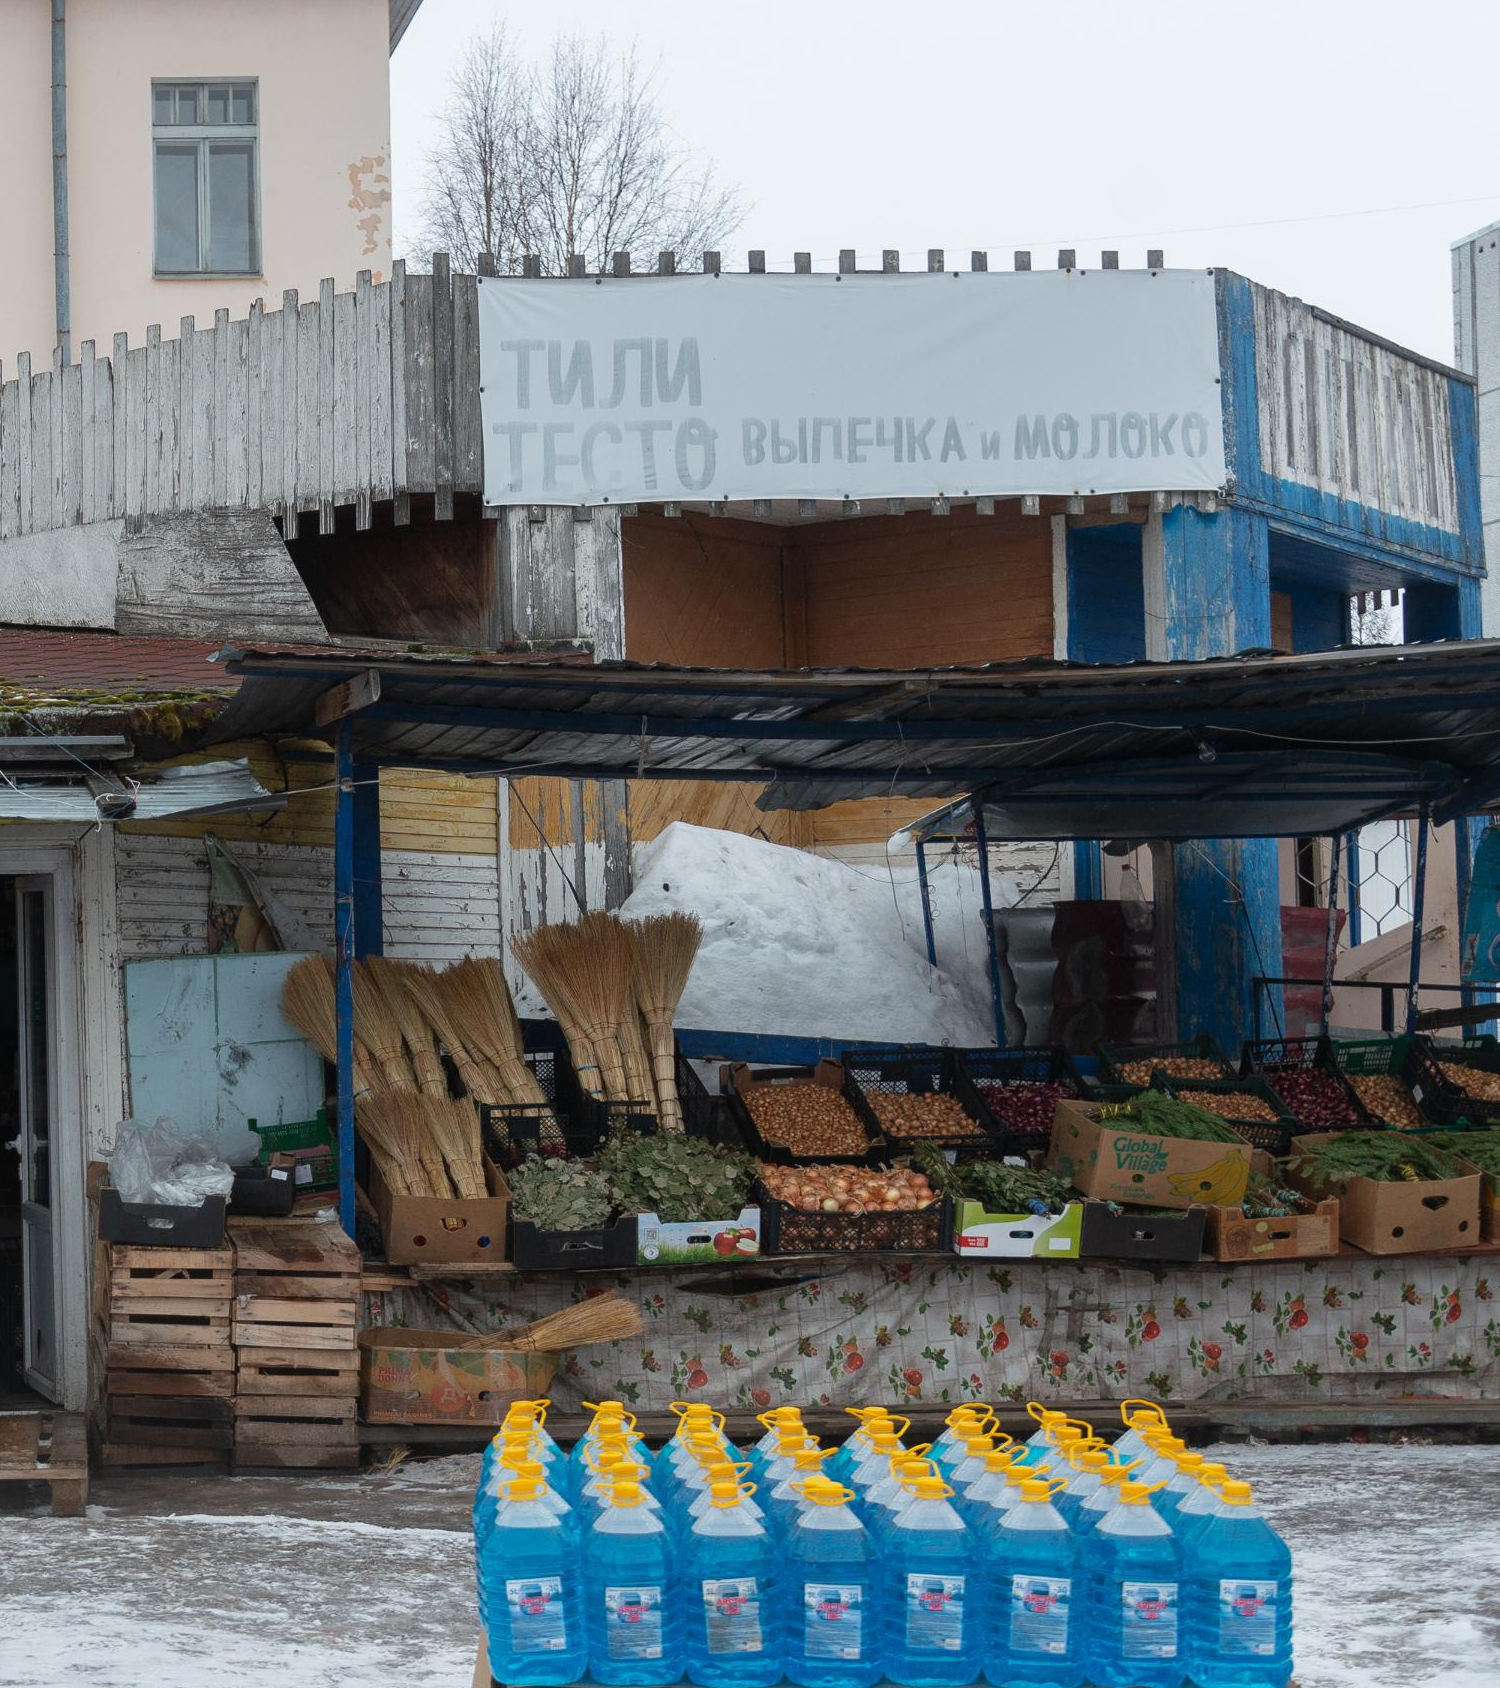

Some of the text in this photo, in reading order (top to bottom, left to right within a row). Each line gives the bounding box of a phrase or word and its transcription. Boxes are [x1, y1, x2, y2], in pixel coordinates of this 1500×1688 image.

[501, 337, 702, 409] ТИЛИ
[492, 411, 1209, 491] ТЕСТО ВЫПЕЧКА и МОЛОКО
[1113, 1136, 1165, 1153] Global
[1116, 1153, 1168, 1174] Village
